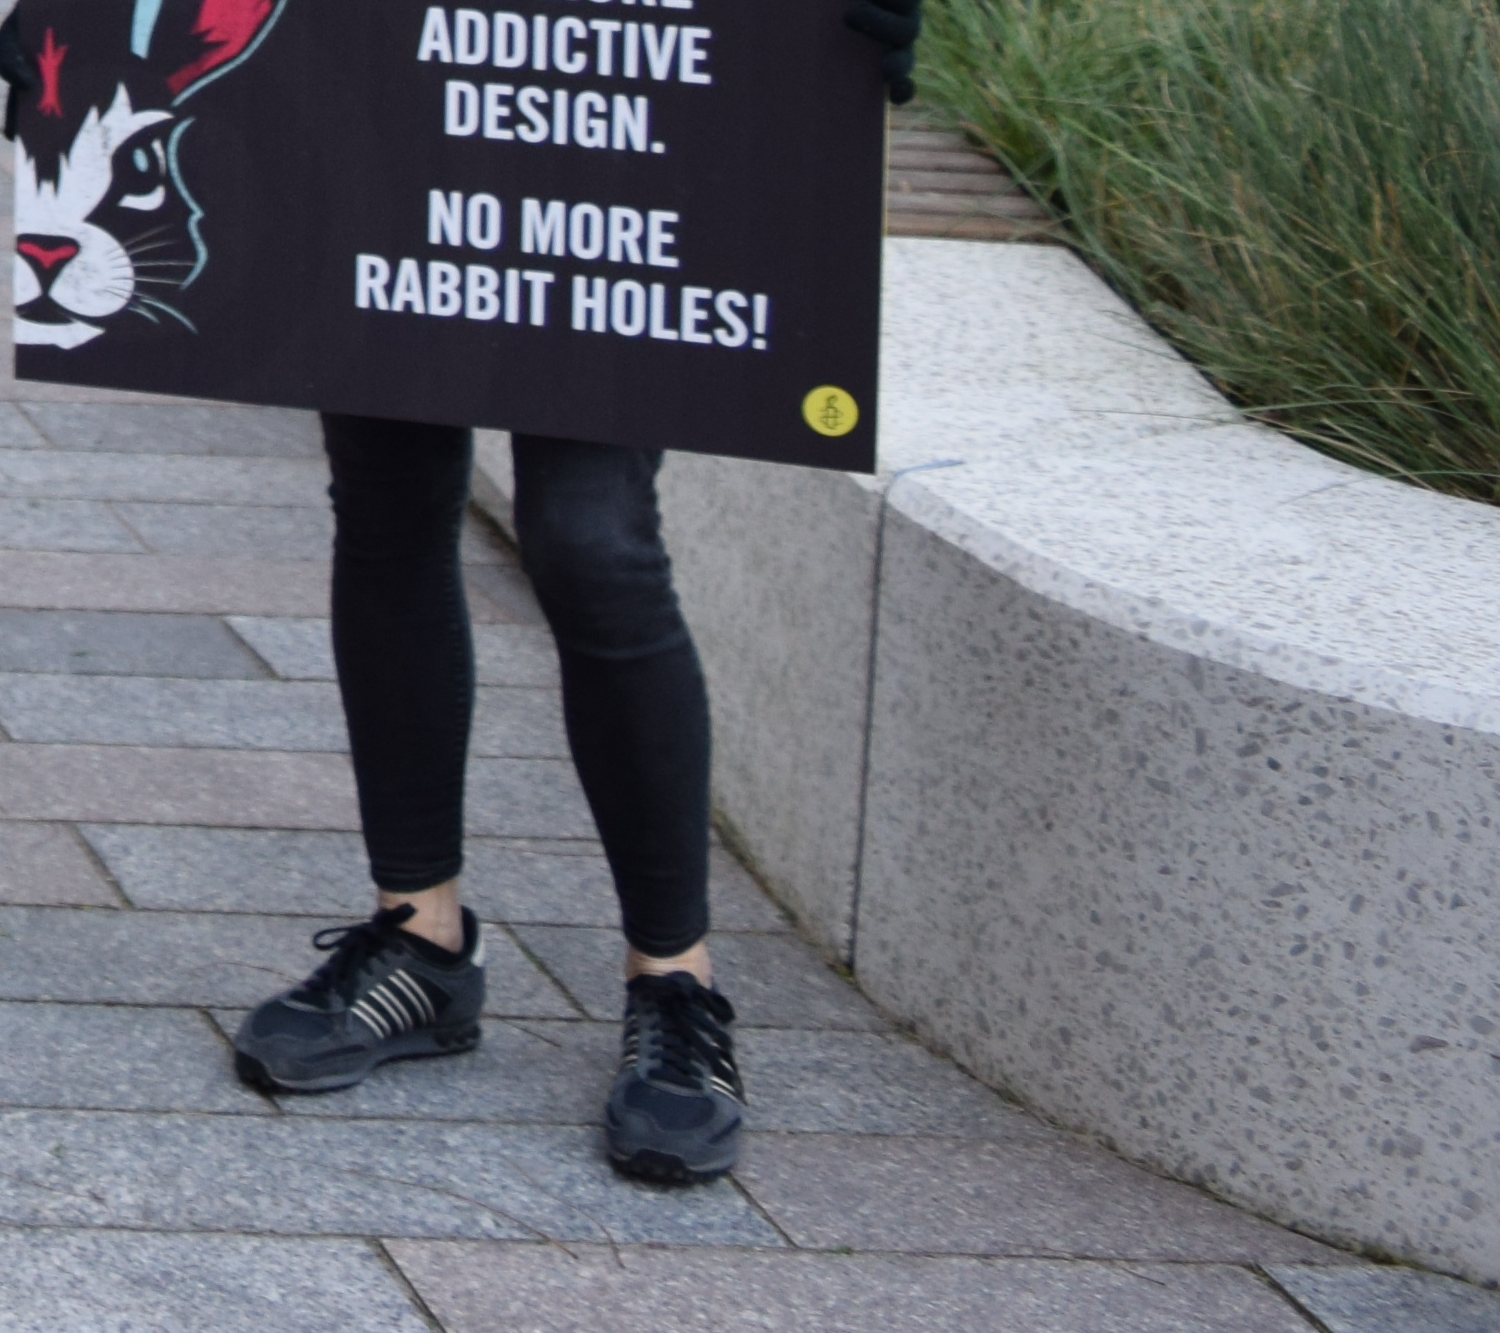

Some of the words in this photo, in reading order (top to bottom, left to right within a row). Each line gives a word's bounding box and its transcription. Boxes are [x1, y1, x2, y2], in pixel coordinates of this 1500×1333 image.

[417, 6, 712, 85] ADDICTIVE
[445, 80, 665, 154] DESIGN.
[428, 189, 501, 250] NO
[521, 198, 679, 268] MORE
[355, 253, 555, 326] RABBIT
[572, 275, 768, 350] HOLES!
